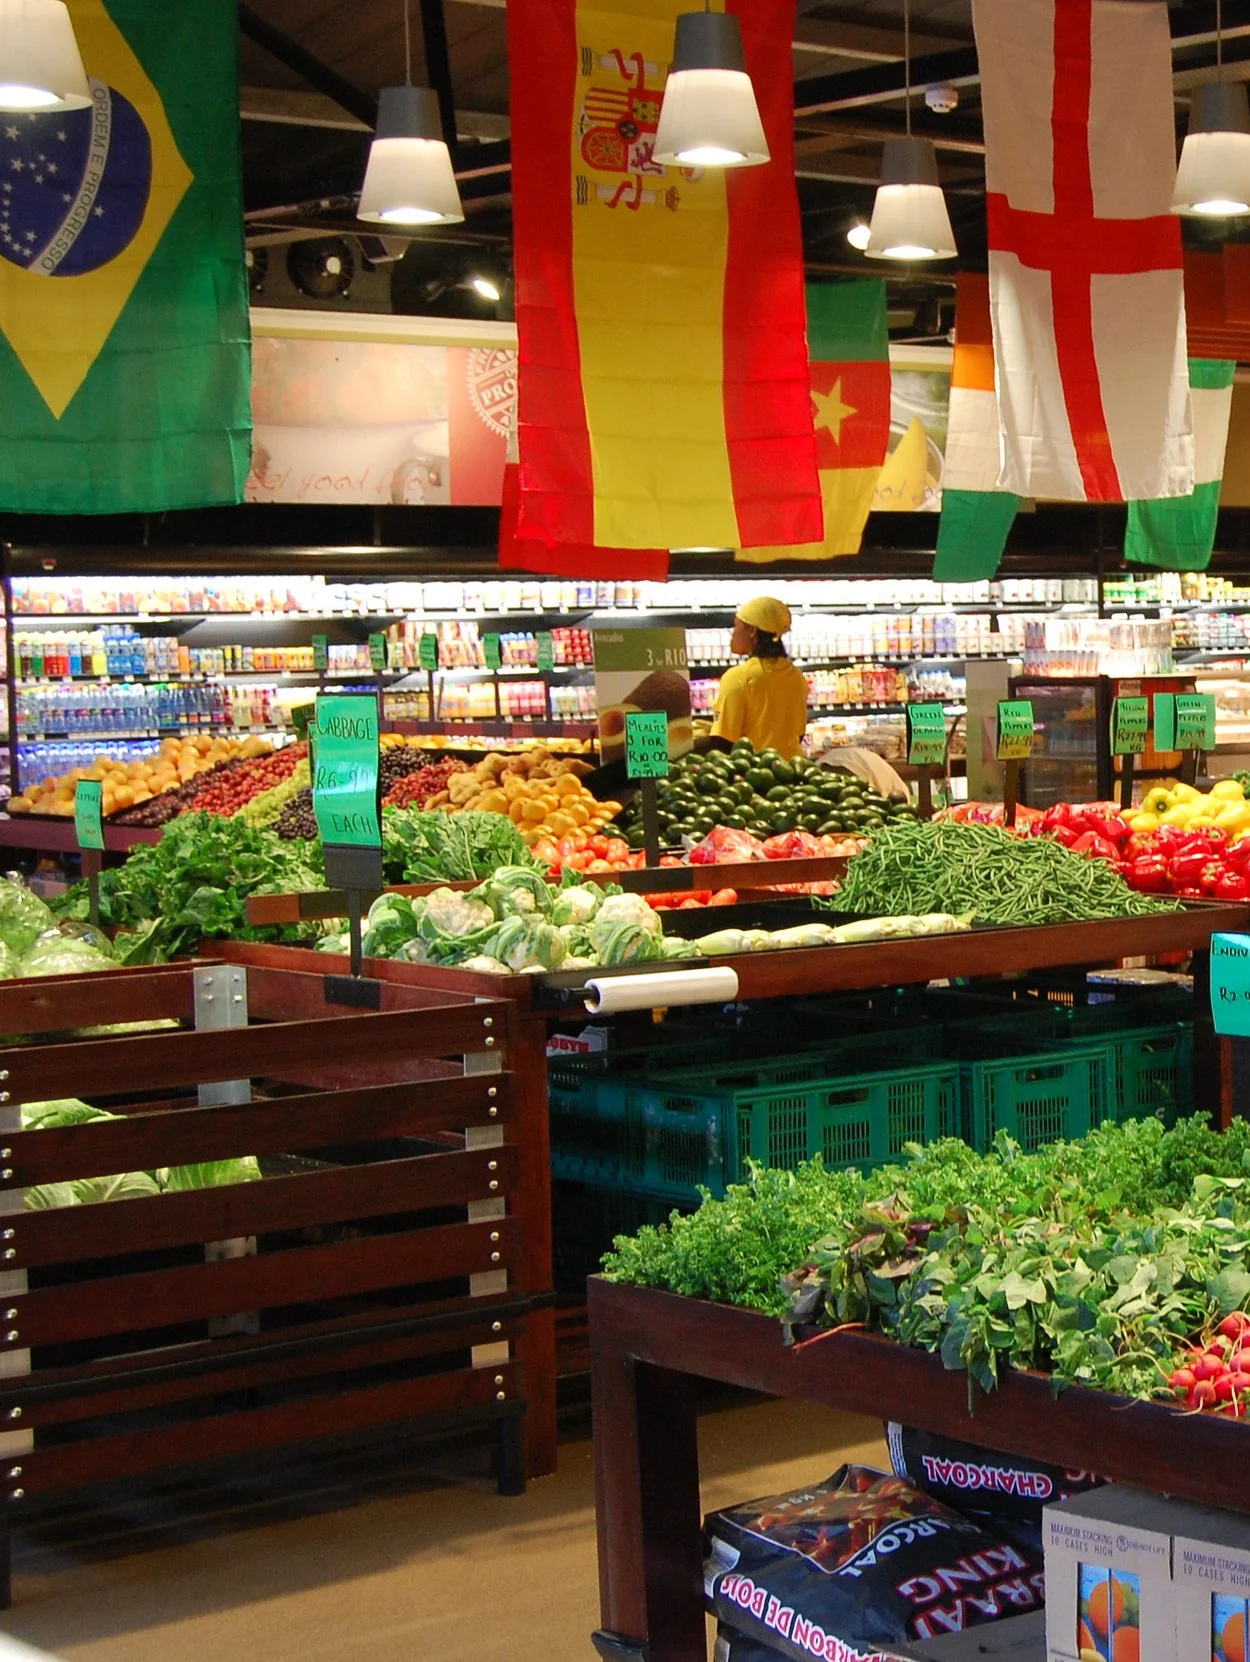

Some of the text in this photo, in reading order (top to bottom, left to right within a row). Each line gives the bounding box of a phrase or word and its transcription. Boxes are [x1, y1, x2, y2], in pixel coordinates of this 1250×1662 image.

[41, 87, 109, 271] ORDEM E PROGRESSO
[647, 649, 654, 667] 3
[664, 648, 686, 666] R10
[316, 707, 374, 741] CABBAGE
[641, 736, 665, 747] FOR
[331, 813, 373, 835] EACH
[921, 1454, 1054, 1499] CHARCOAL
[1050, 1522, 1113, 1545] MAXIMUM STACKING
[1050, 1535, 1113, 1557] 10 CASES HIGH
[897, 1544, 1028, 1606] KING
[1183, 1551, 1250, 1575] MAXIMUM STACKING
[1183, 1563, 1250, 1587] 10 CASES HIGH
[719, 1573, 768, 1620] BOIS
[764, 1594, 795, 1638] DE
